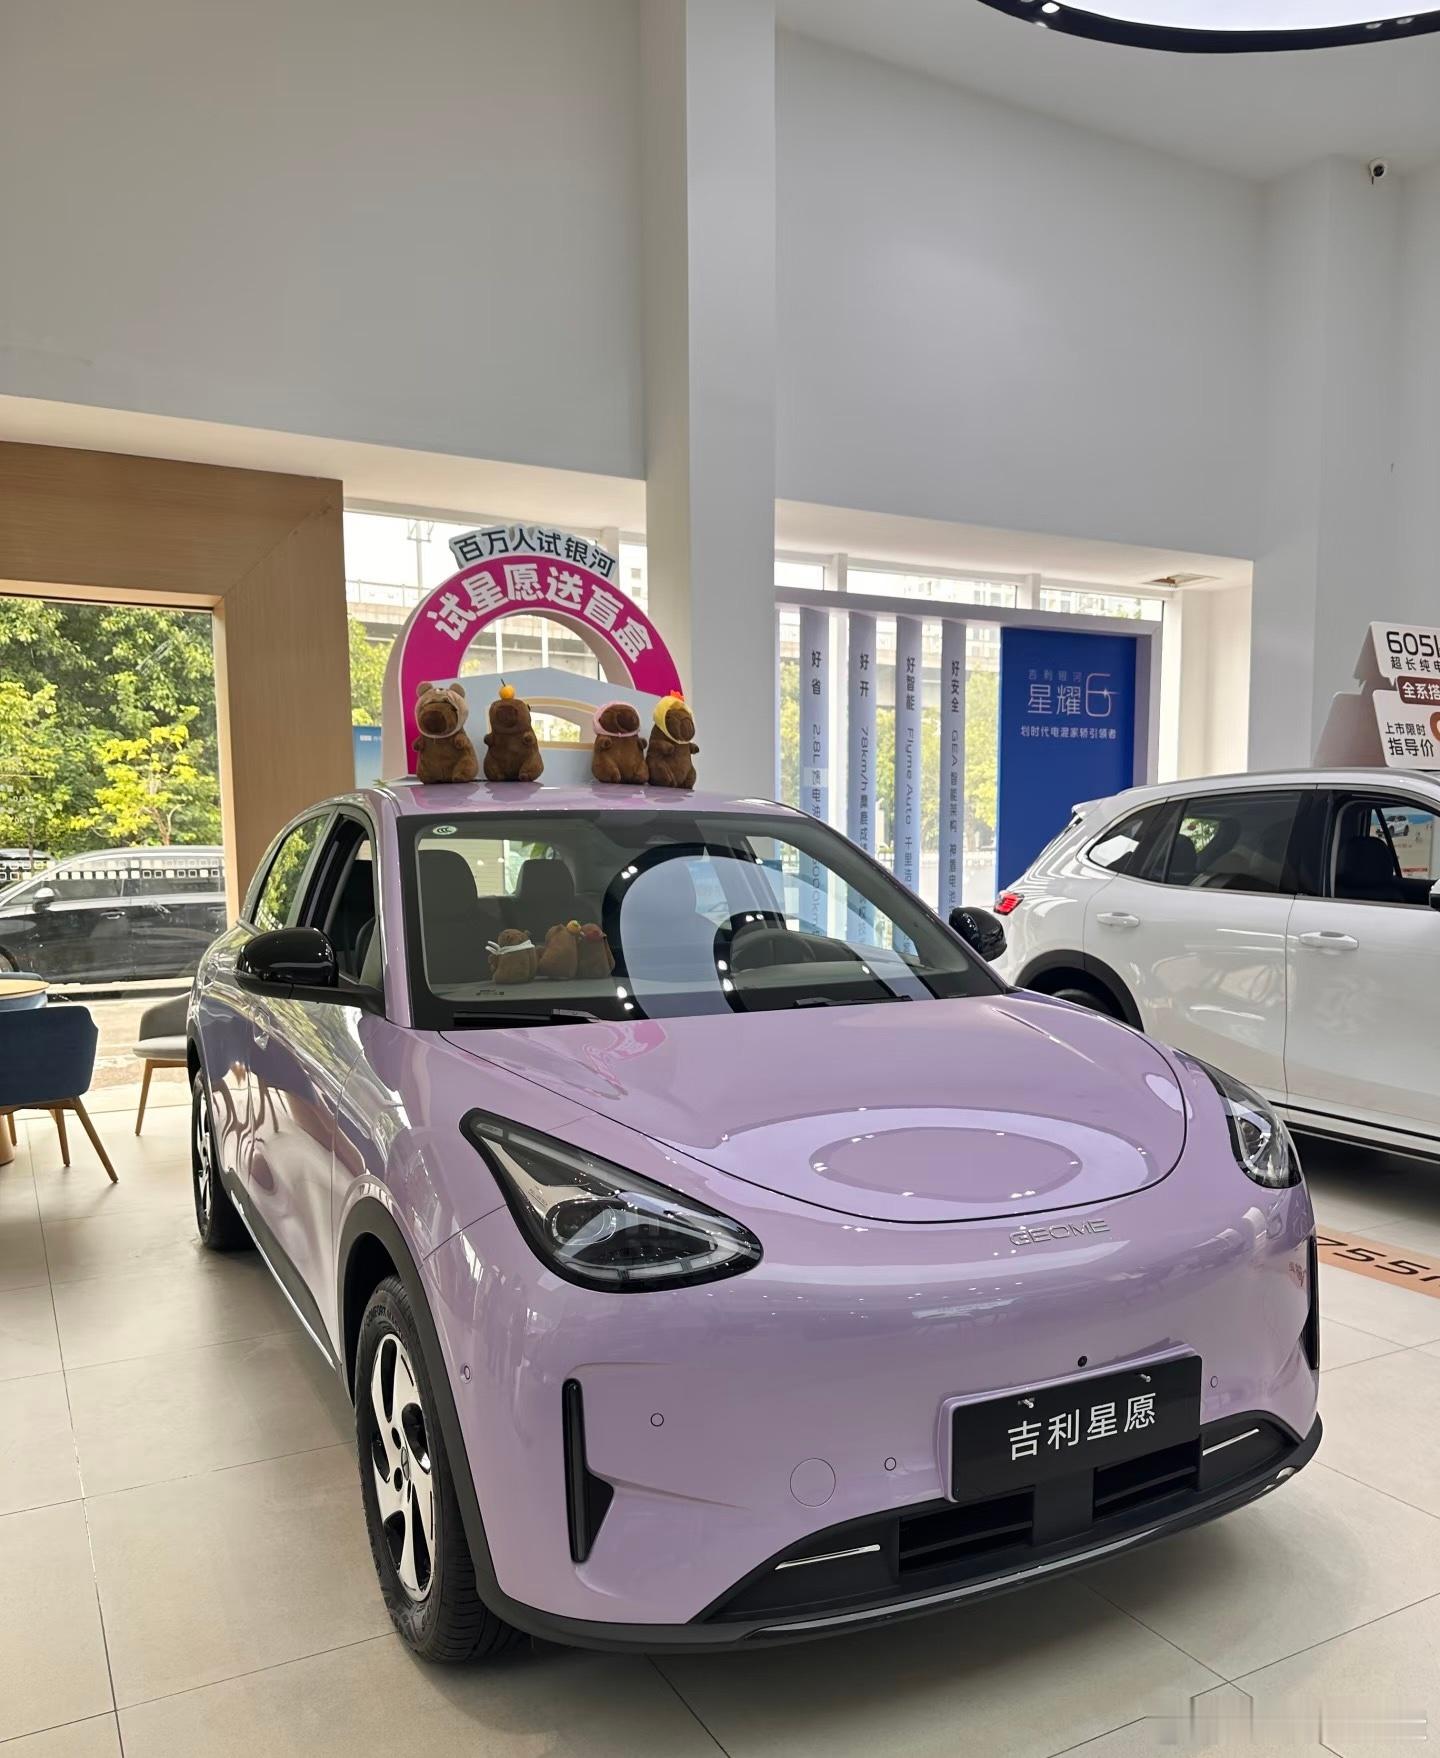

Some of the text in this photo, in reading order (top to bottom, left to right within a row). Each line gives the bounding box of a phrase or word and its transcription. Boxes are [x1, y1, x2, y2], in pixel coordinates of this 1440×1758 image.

[453, 528, 616, 578] 百万人试银河
[427, 562, 655, 664] 试星愿送盲盒
[811, 650, 822, 696] 好省
[859, 652, 870, 697] 好开
[906, 655, 916, 711] 好智能
[951, 660, 960, 714] 好安全
[905, 727, 914, 778] Flyme
[1385, 722, 1426, 737] 上市限时
[1388, 737, 1434, 758] 指导价
[904, 784, 914, 825] Auto
[1009, 1219, 1112, 1246] GEOME
[1007, 1392, 1157, 1461] 吉利星愿
